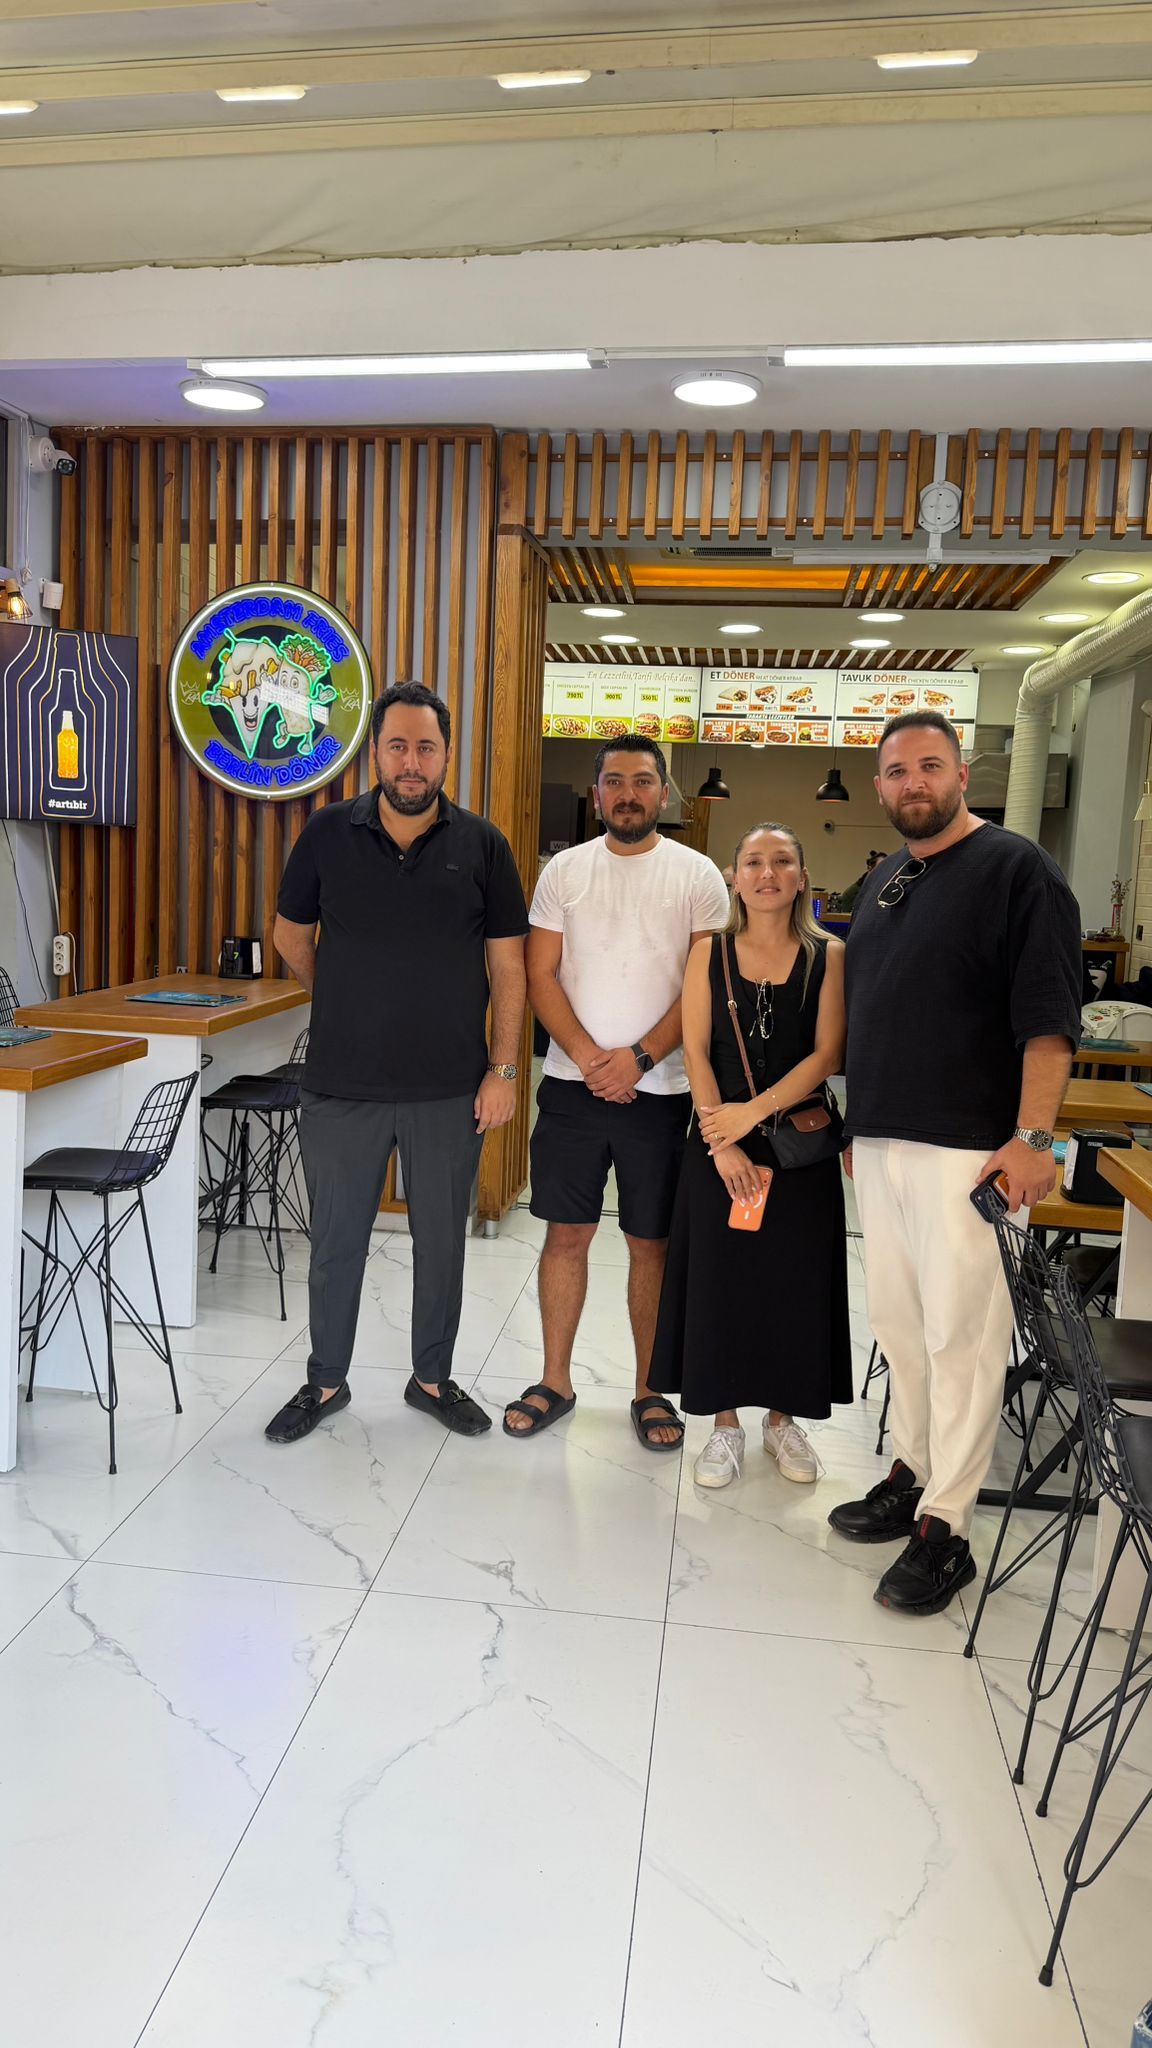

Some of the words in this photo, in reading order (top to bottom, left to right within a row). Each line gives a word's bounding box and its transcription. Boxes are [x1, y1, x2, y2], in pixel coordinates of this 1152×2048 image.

[190, 597, 304, 661] AMSTERDAM
[302, 611, 349, 662] FRIES
[710, 671, 722, 679] ET
[723, 670, 755, 680] DÖNER
[841, 674, 872, 682] TAVUK
[873, 673, 907, 683] DÖNER
[274, 735, 342, 786] DÖNER
